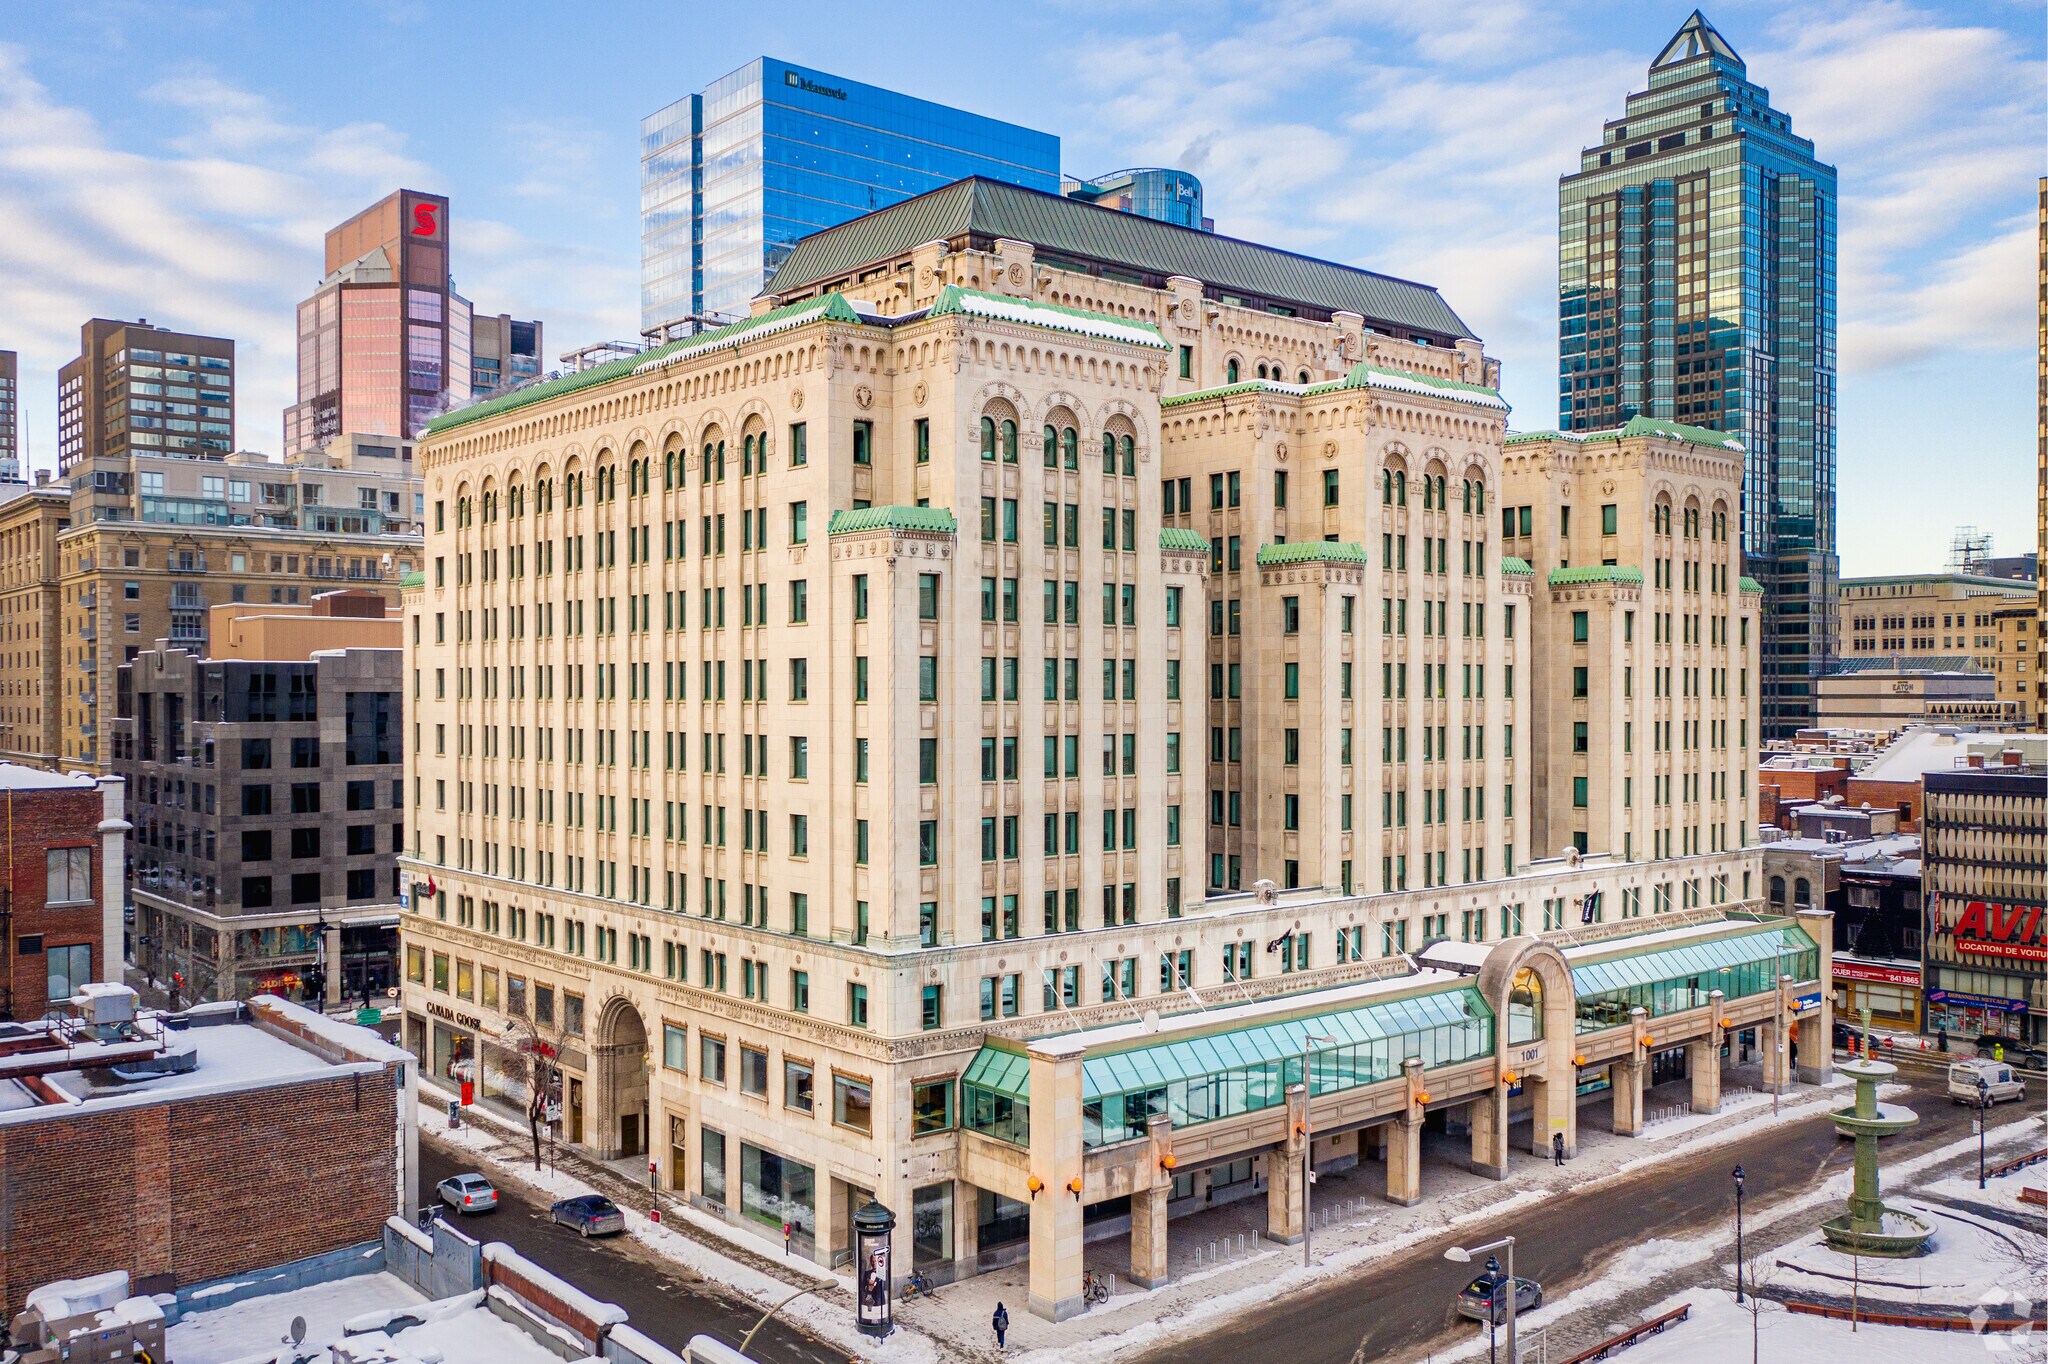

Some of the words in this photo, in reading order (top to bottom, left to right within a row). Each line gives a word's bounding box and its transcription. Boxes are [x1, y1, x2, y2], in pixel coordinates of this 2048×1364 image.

[1179, 184, 1193, 197] Bell
[1953, 901, 2048, 945] AVI
[1960, 943, 2002, 953] LOCATION
[2005, 947, 2018, 955] DE
[1890, 974, 1901, 982] 841
[1902, 975, 1919, 984] 3865
[426, 1001, 455, 1023] CANADA
[457, 1012, 481, 1031] GOOSE
[1521, 1048, 1538, 1061] 1001
